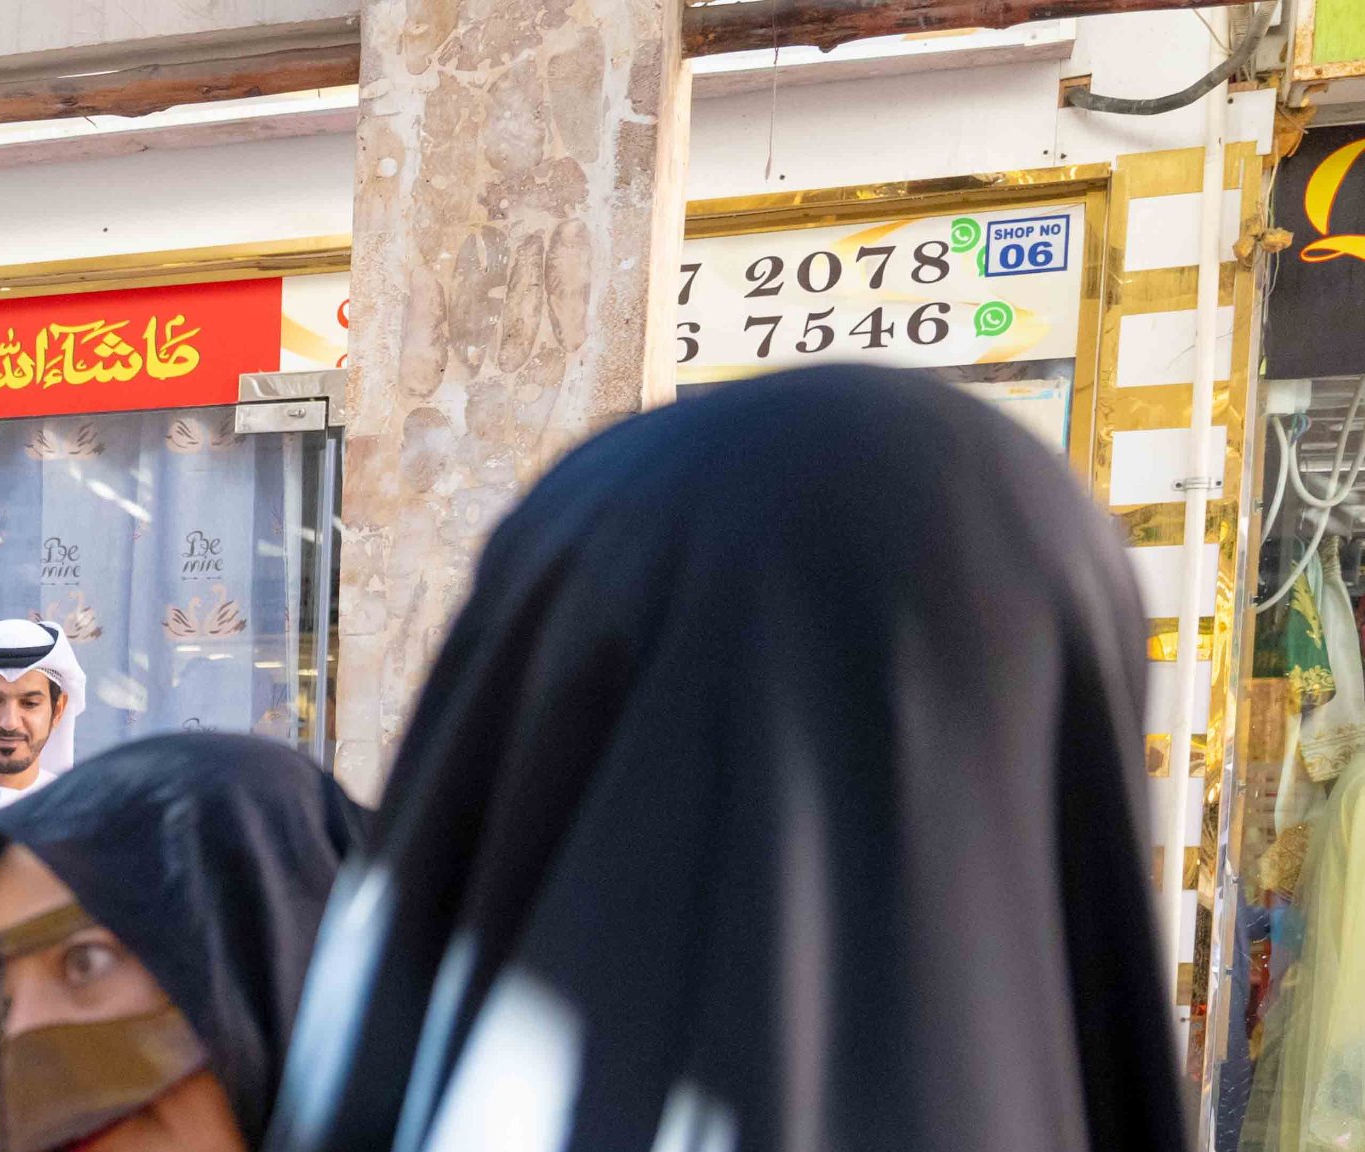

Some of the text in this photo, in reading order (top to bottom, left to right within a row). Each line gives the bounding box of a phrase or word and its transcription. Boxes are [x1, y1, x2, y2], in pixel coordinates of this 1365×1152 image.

[994, 223, 1062, 241] SHOP NO
[743, 240, 951, 299] 2078
[999, 241, 1054, 270] 06
[743, 302, 952, 358] 7546
[41, 537, 81, 562] Be
[181, 530, 223, 558] Be
